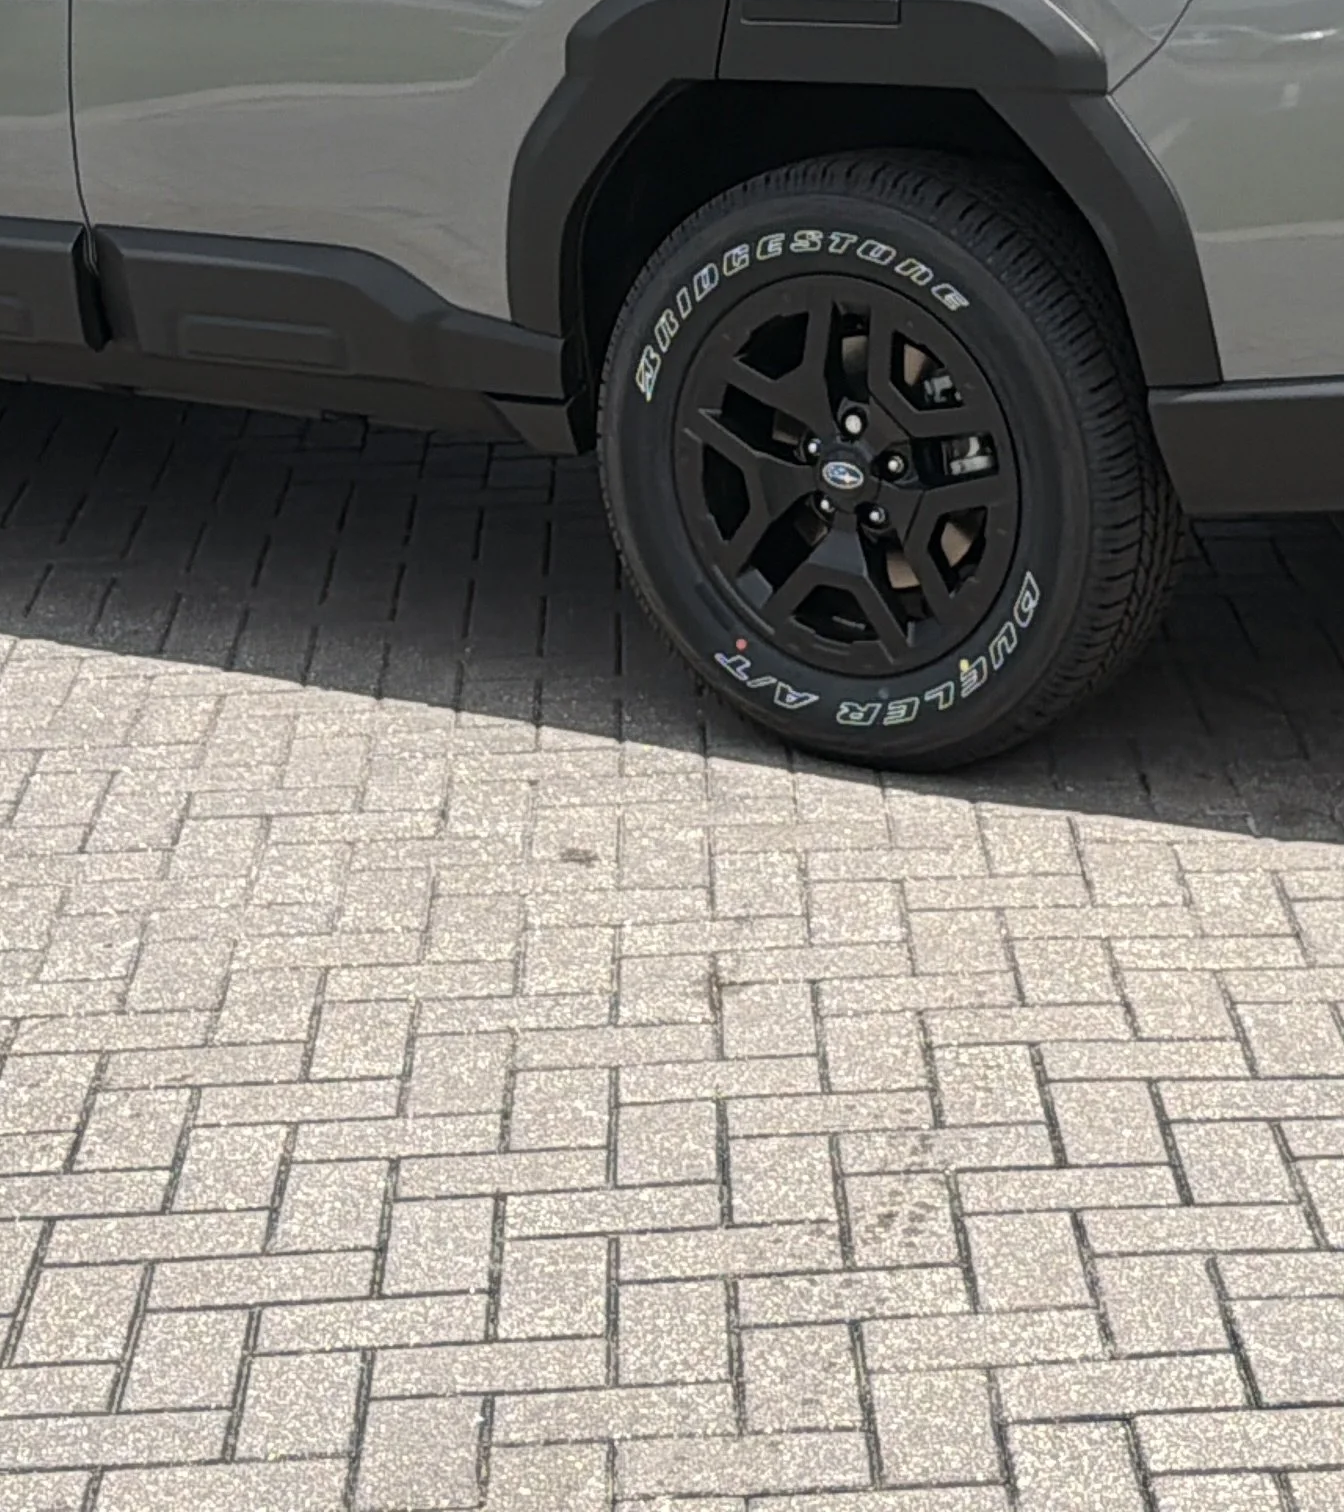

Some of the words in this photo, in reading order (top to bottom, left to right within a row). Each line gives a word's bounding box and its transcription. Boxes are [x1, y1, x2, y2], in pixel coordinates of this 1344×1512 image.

[635, 229, 971, 404] BRIDGESTONE
[713, 650, 820, 710] A/T
[835, 571, 1042, 727] DUELER
